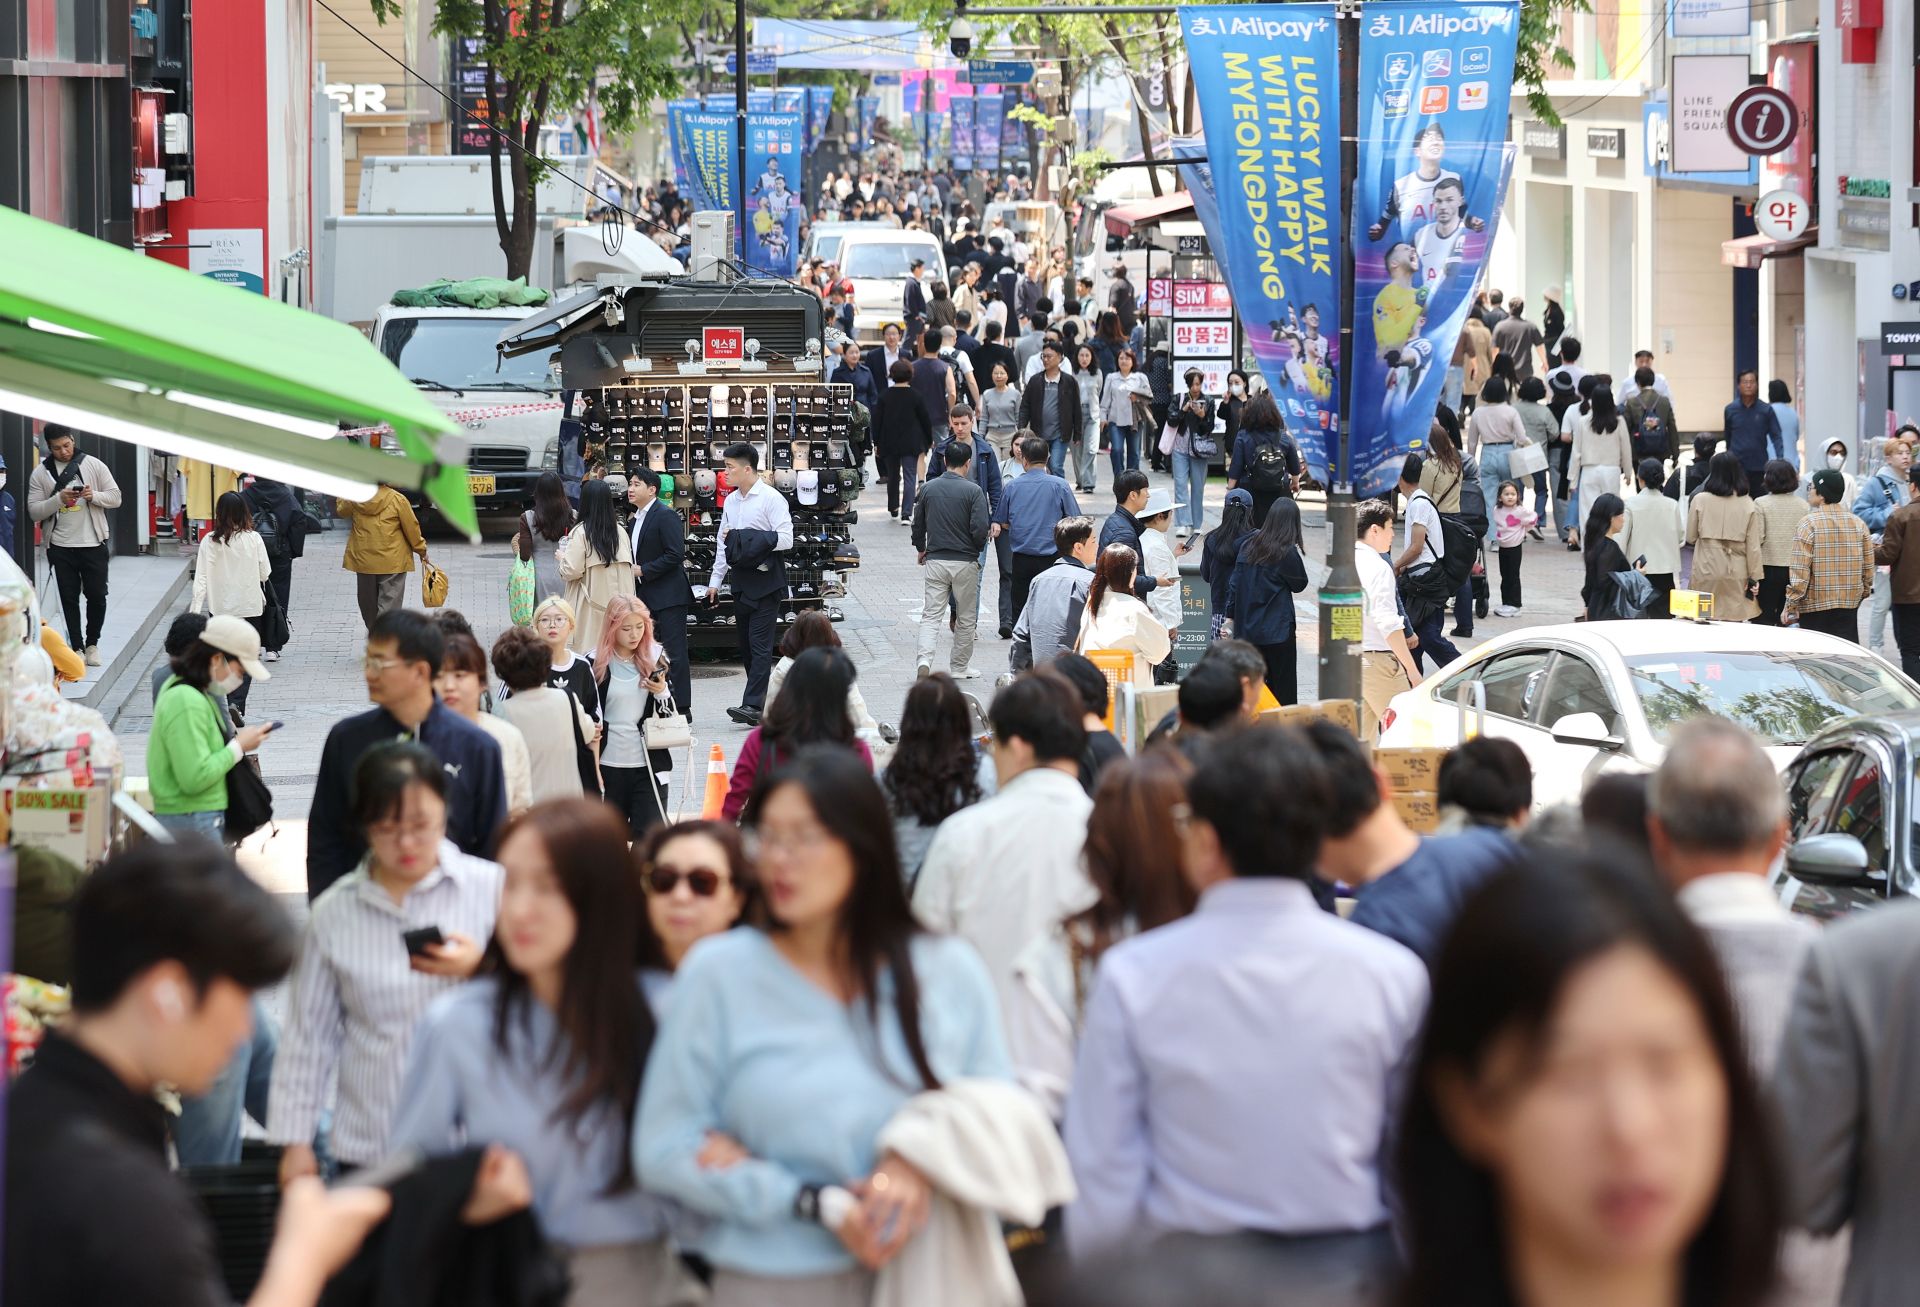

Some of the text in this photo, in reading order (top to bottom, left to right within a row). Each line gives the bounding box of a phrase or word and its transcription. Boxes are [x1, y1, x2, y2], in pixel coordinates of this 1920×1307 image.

[1231, 17, 1329, 42] Alipay+
[1684, 97, 1713, 105] LINE
[718, 131, 728, 171] LUCKY
[1258, 54, 1305, 266] WITH HAPPY
[1291, 55, 1332, 277] LUCKY WALK
[1222, 52, 1285, 300] MYEONGDONG
[1769, 202, 1798, 232] 약
[1175, 289, 1205, 305] SIM
[711, 338, 737, 349] 에스원
[1177, 327, 1228, 344] 상품권
[1182, 585, 1193, 597] 동
[1184, 598, 1205, 609] 거리
[51, 791, 86, 810] SALE
